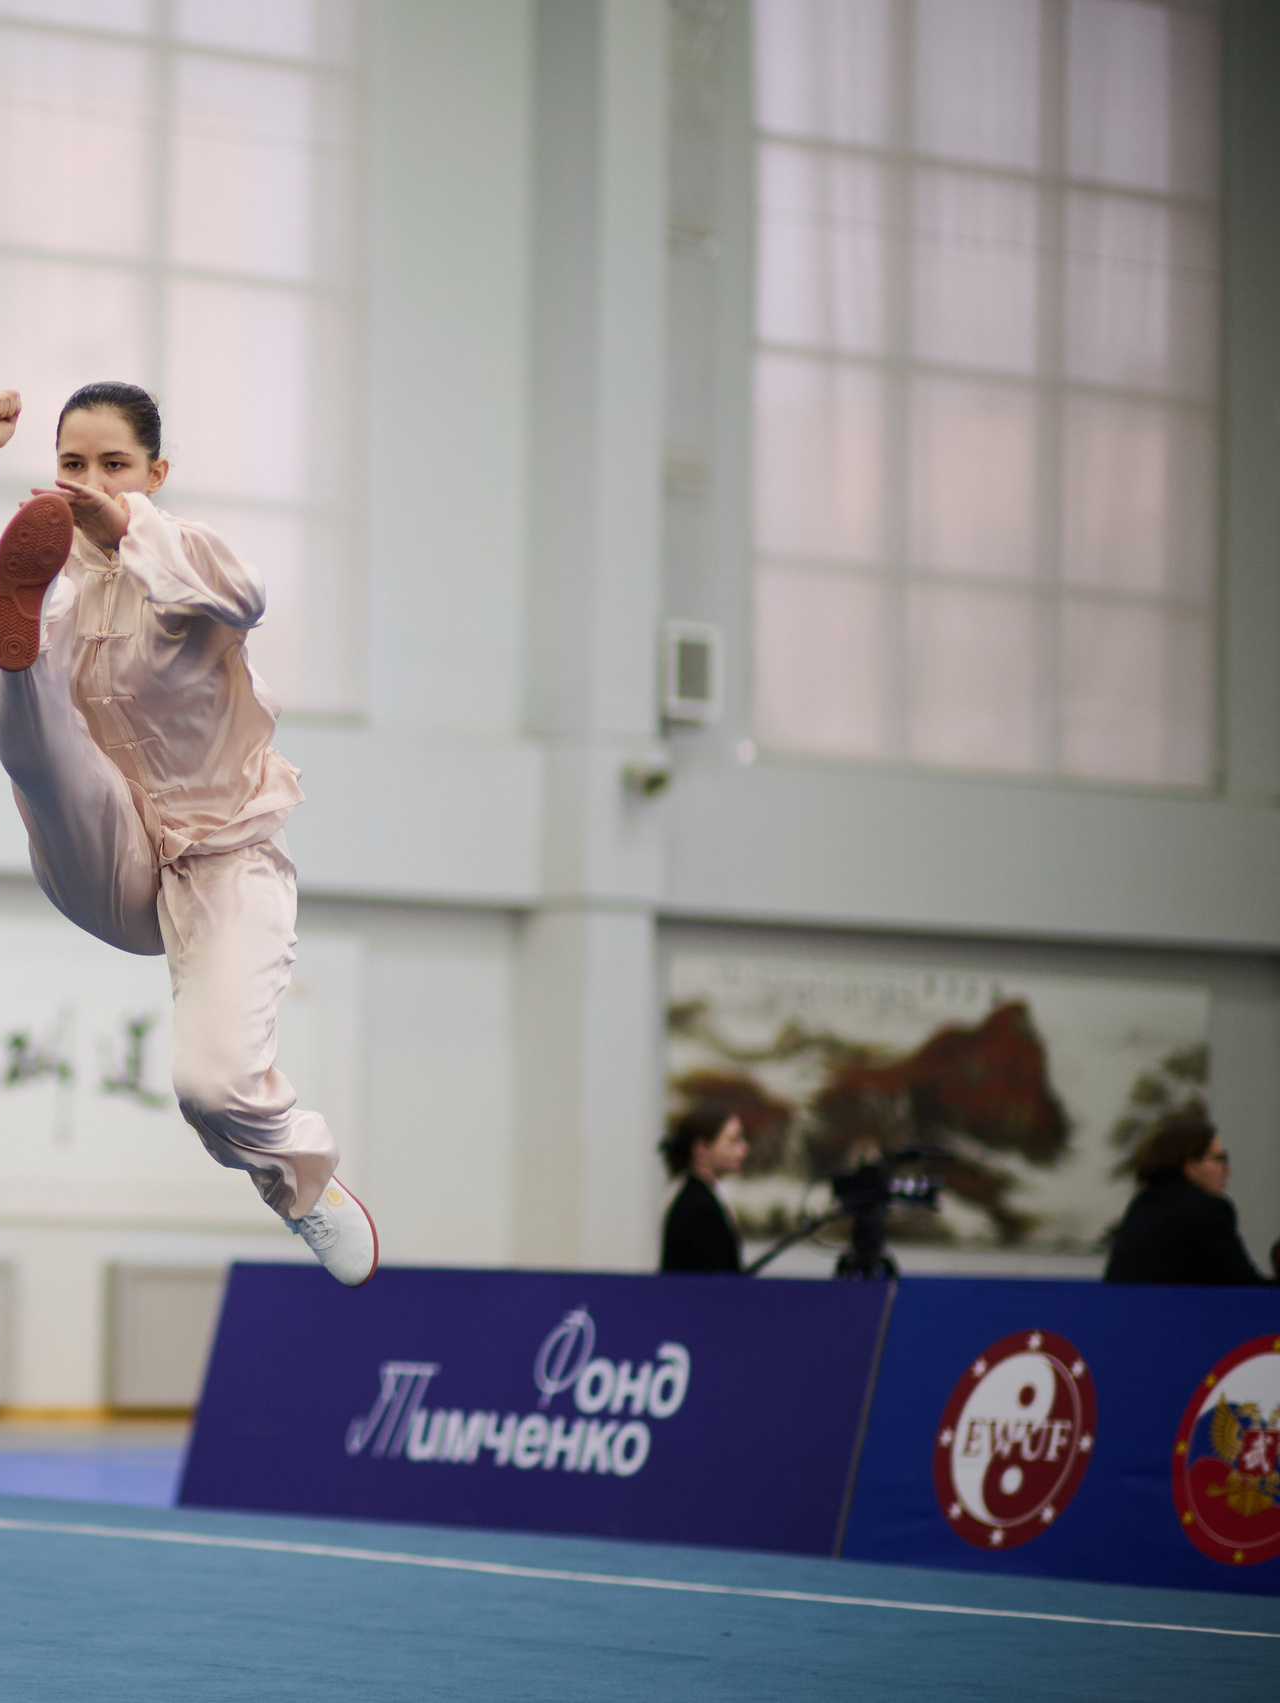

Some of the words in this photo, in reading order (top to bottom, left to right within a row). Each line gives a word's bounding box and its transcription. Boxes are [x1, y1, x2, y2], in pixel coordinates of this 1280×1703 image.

[345, 1361, 651, 1477] Тимченко
[533, 1304, 691, 1419] Фонд
[961, 1417, 1072, 1462] EWUF
